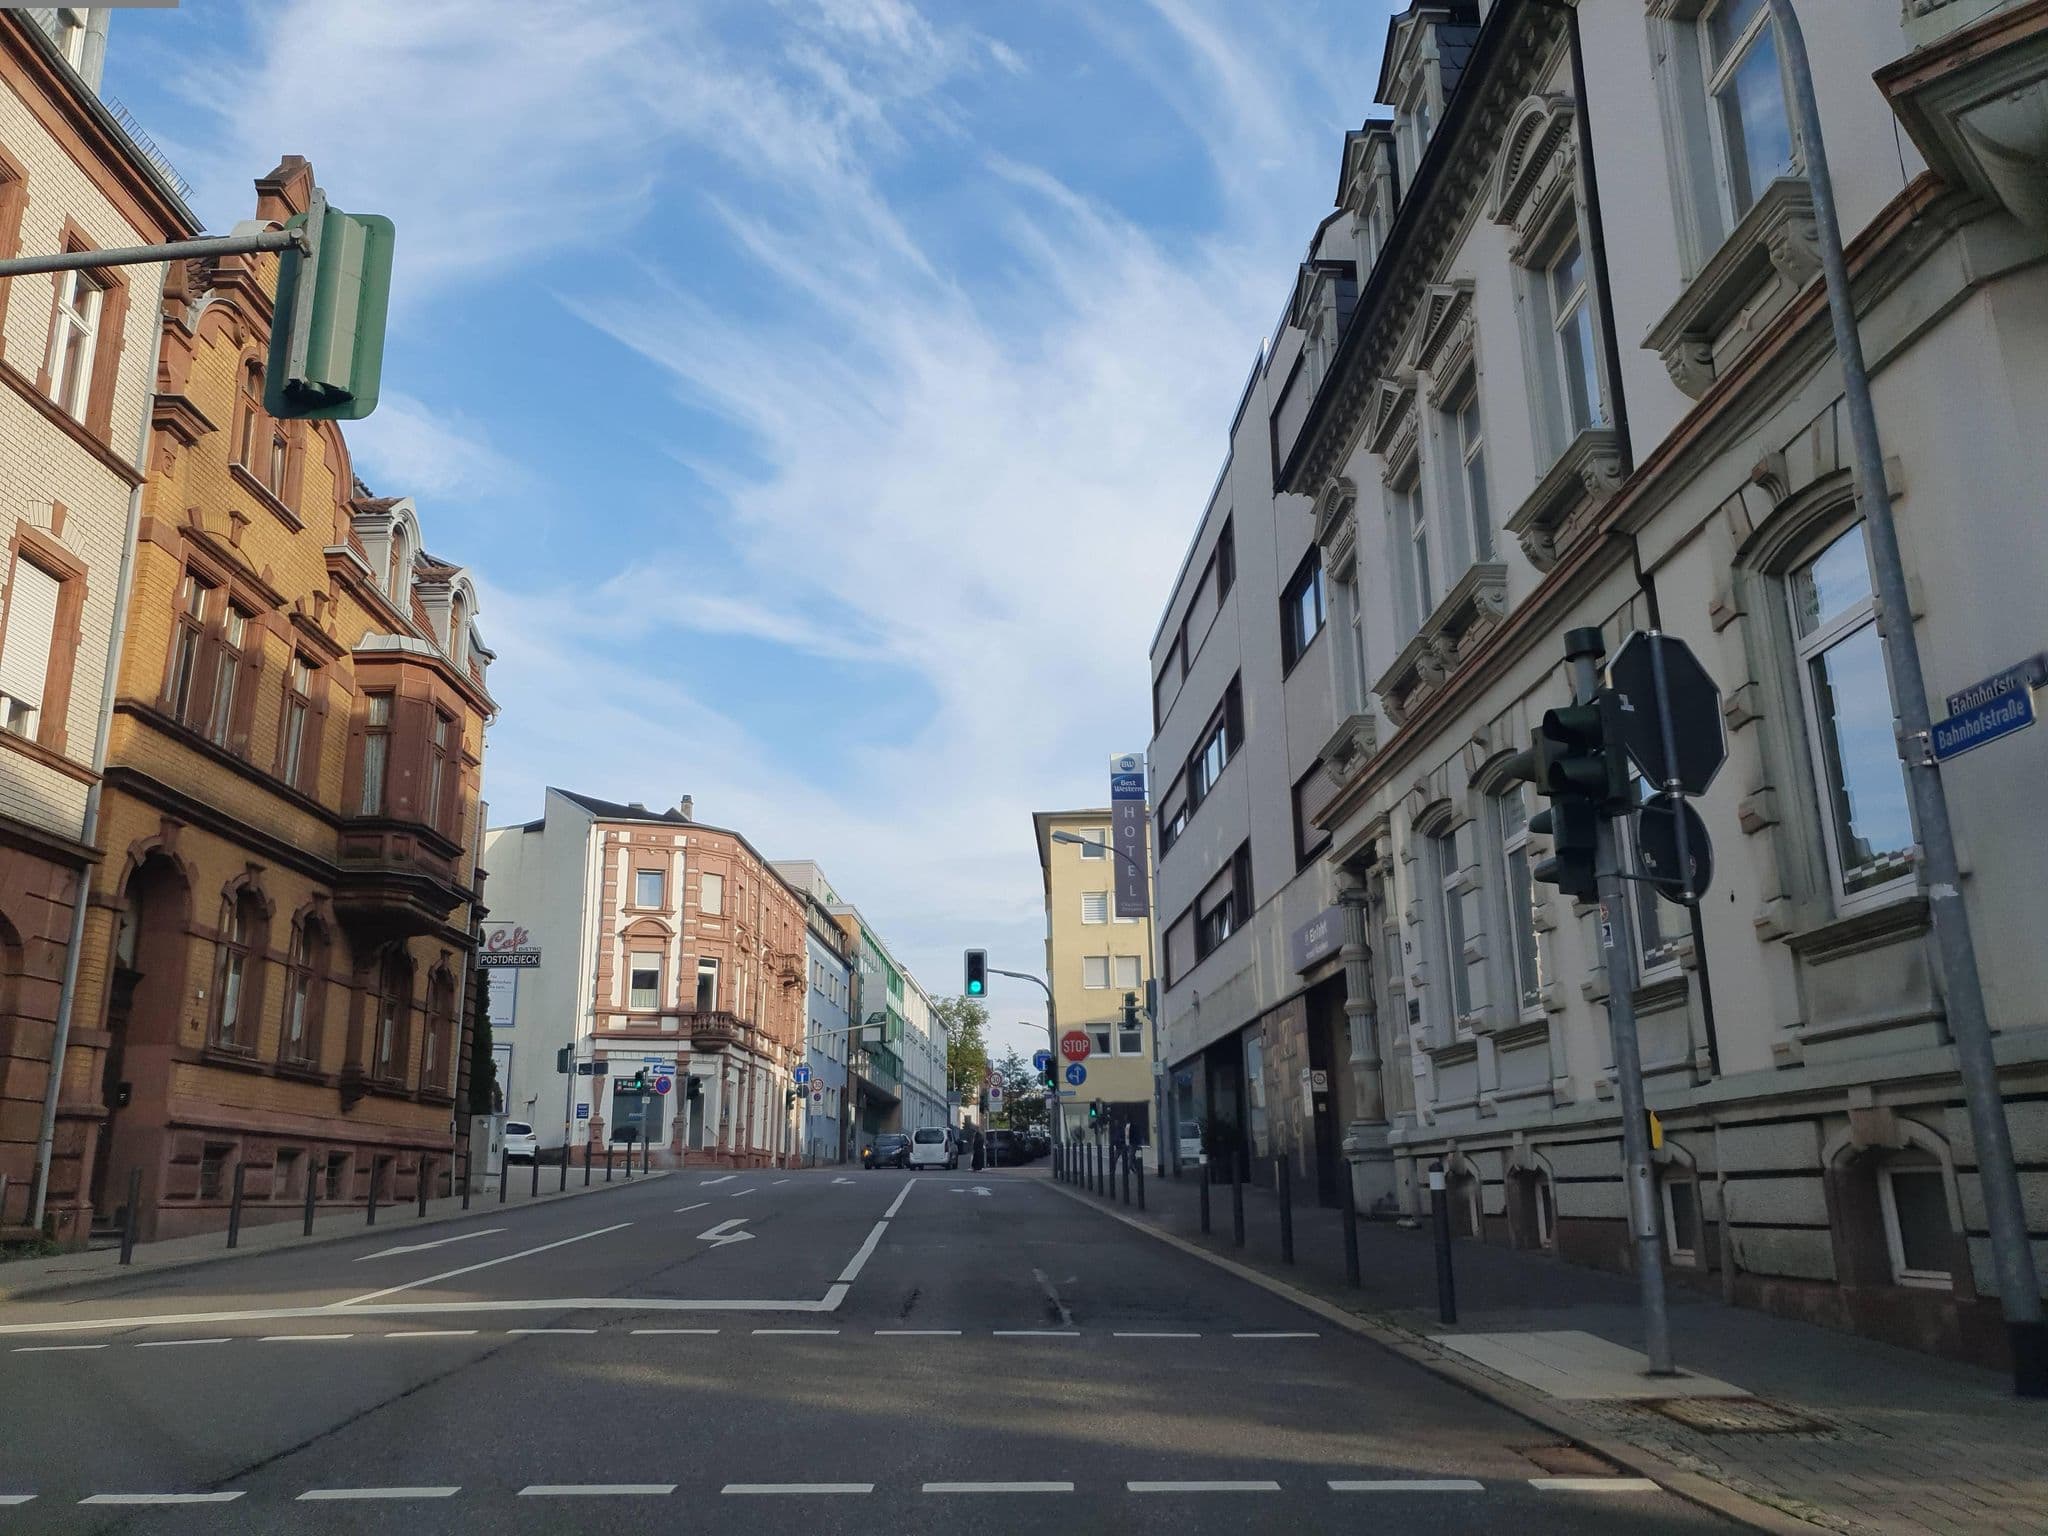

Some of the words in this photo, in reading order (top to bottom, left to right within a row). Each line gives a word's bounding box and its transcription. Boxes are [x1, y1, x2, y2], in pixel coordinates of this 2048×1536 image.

[1937, 698, 2025, 749] Bahnhofstraße
[1123, 806, 1137, 897] HOTEL
[480, 955, 538, 965] POSTDREIECK
[1063, 1039, 1089, 1053] STOP
